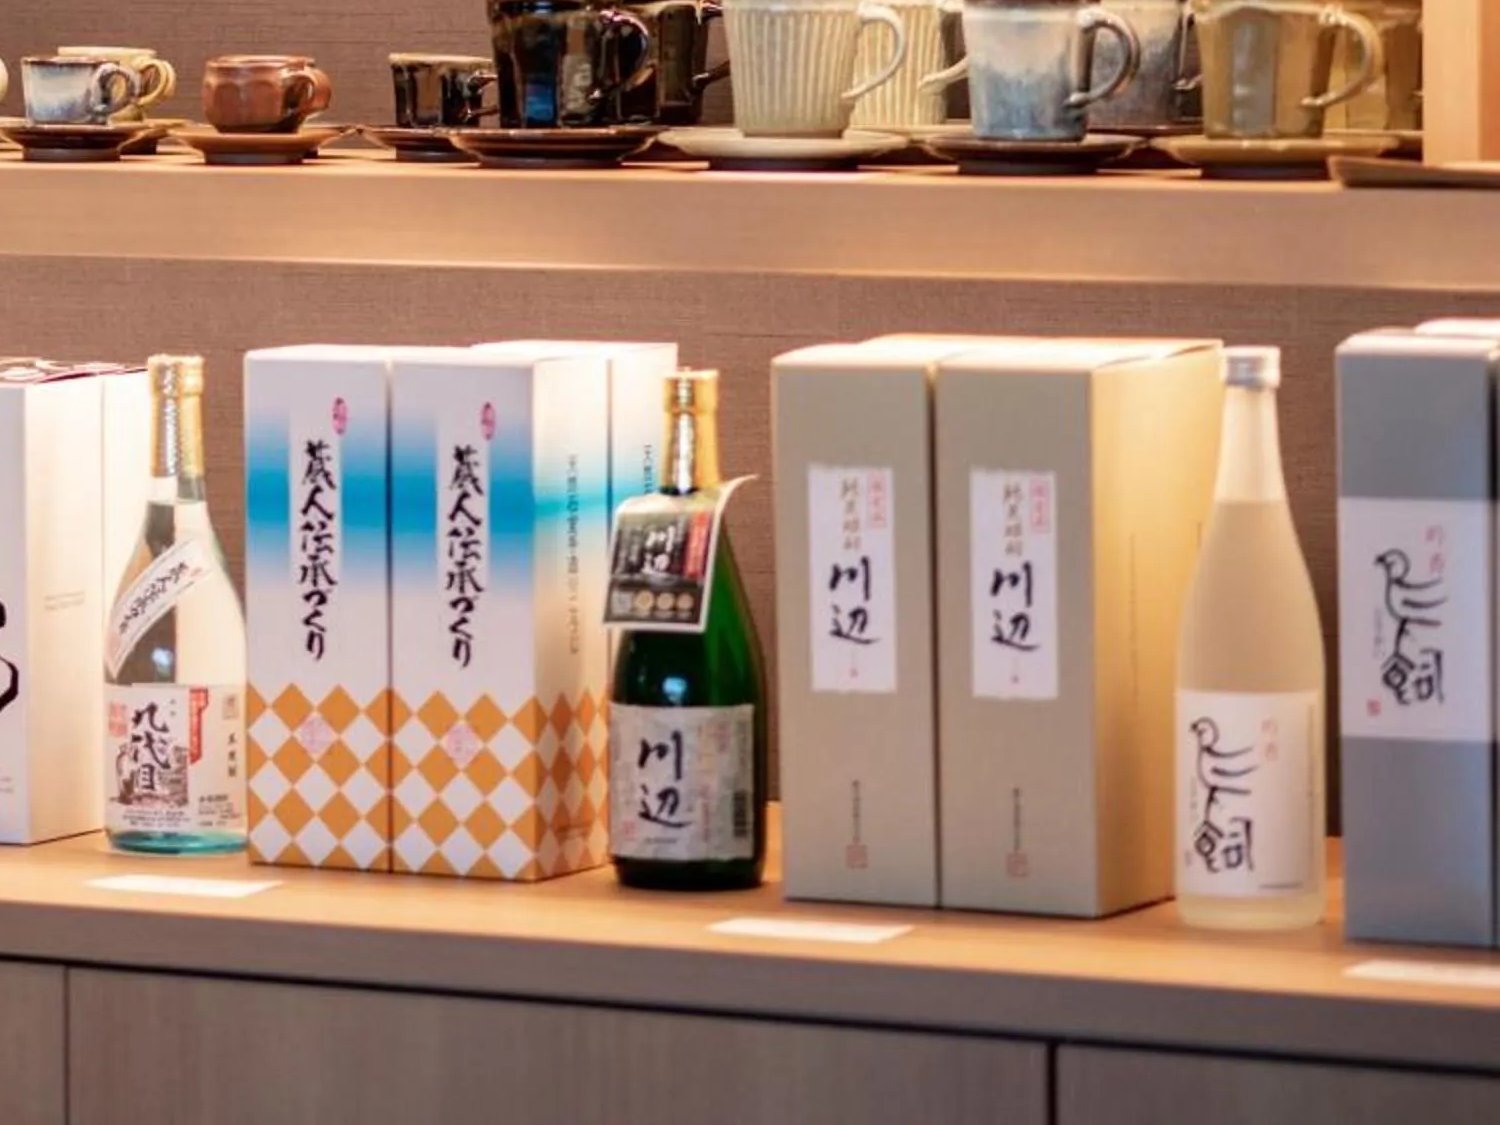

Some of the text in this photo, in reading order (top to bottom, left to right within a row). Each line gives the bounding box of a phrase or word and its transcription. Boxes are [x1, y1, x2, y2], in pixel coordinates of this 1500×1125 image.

[297, 440, 338, 661] 蔵人伝承づくり
[446, 445, 484, 668] 蔵人伝承づくり
[641, 525, 676, 577] 川辺
[829, 556, 881, 645] 川辺
[991, 561, 1041, 652] 川辺
[132, 702, 171, 791] 九代目
[638, 730, 696, 829] 川辺
